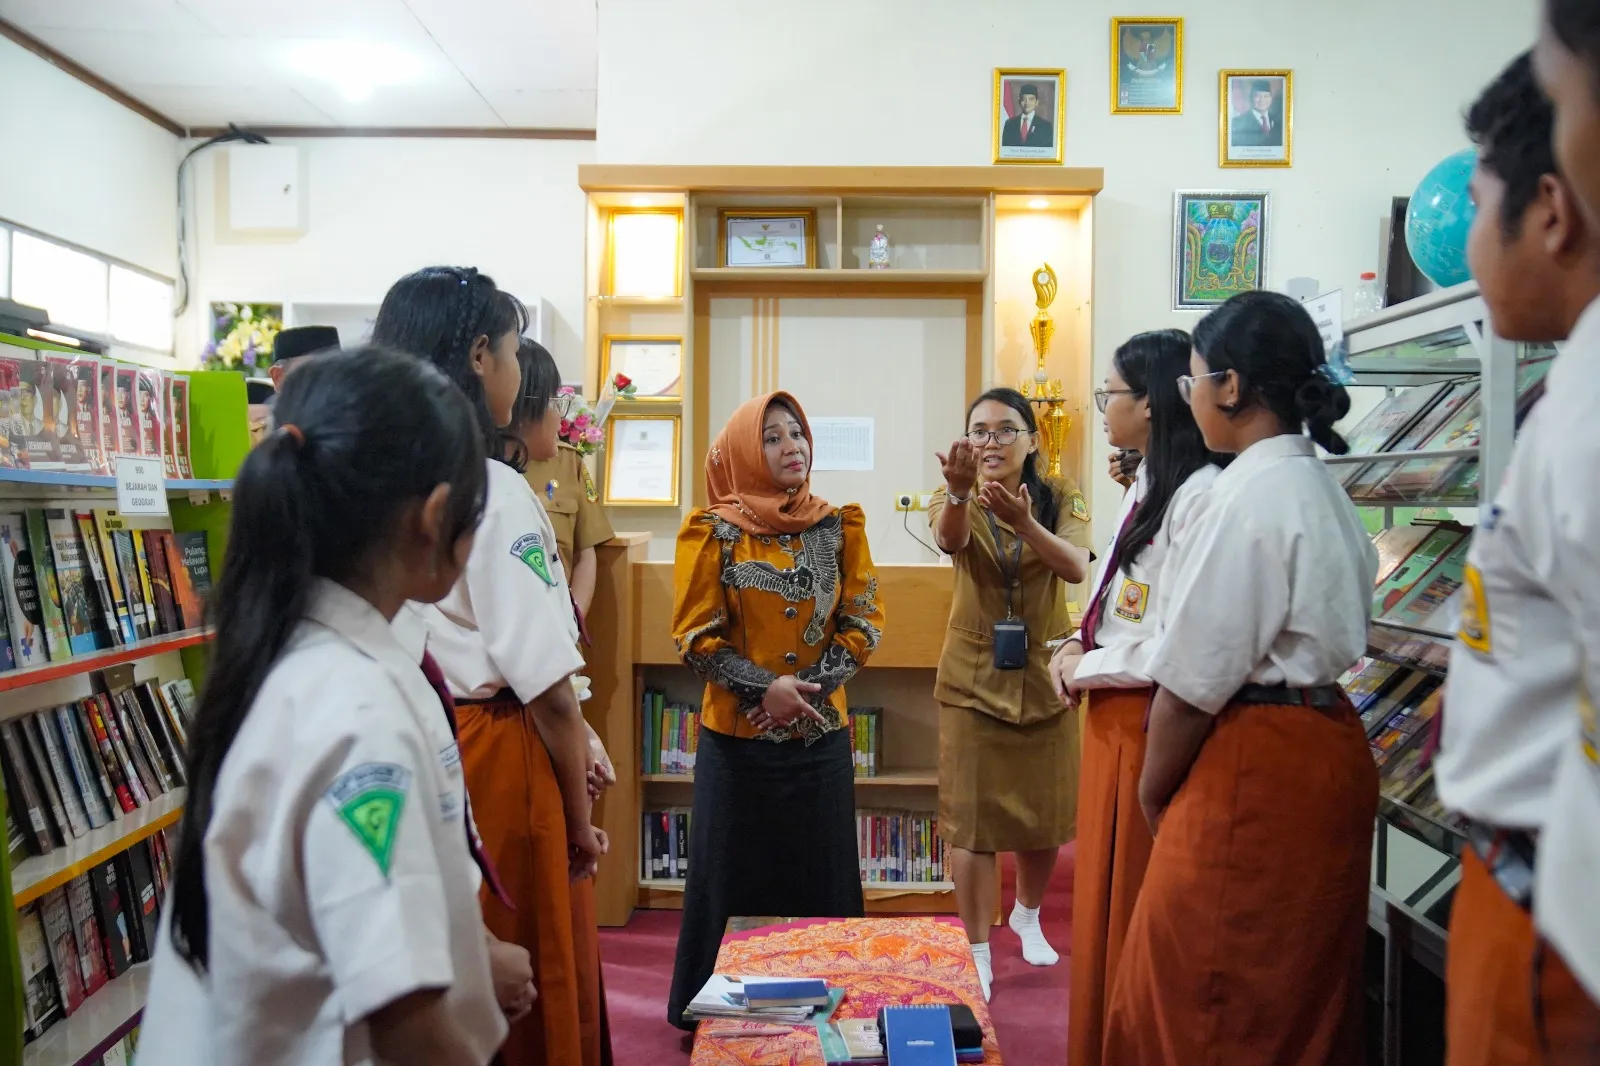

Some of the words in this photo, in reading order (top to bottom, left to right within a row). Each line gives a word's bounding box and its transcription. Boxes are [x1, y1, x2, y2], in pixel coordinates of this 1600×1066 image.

[125, 482, 147, 491] SEJARAH
[131, 498, 156, 506] GEOGRAFI
[194, 565, 208, 575] Lupa
